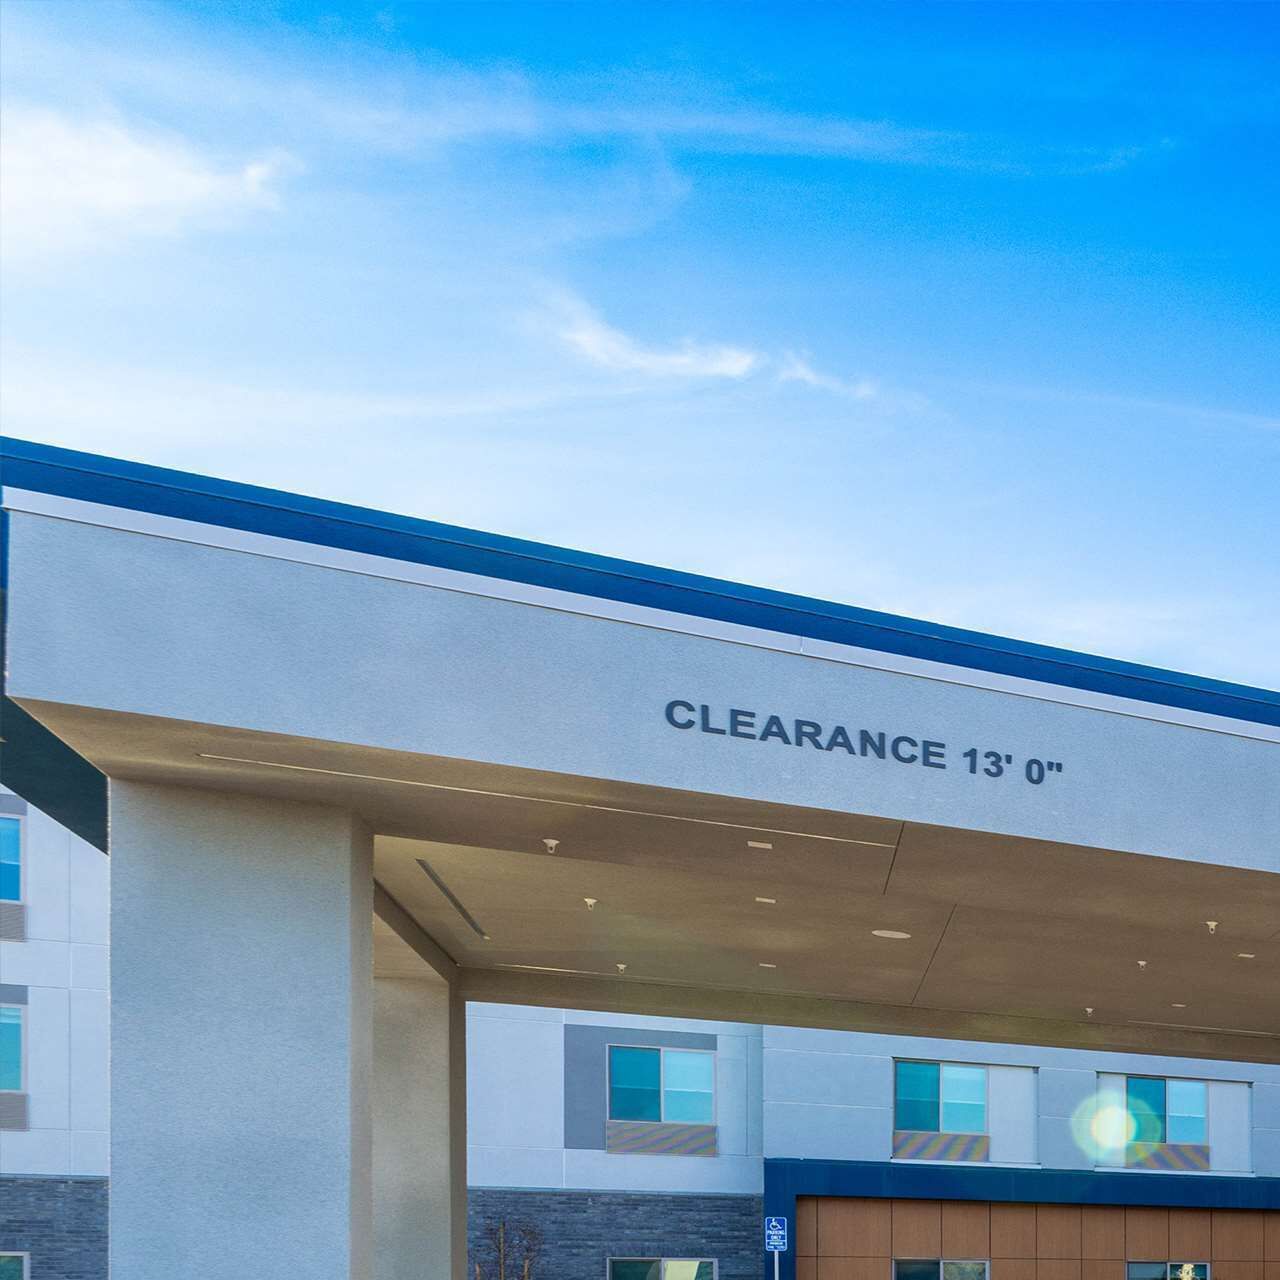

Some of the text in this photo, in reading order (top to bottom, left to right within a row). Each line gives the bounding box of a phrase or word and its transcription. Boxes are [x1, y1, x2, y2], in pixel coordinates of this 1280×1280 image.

[664, 699, 1063, 785] CLEARANCE 13' 0"
